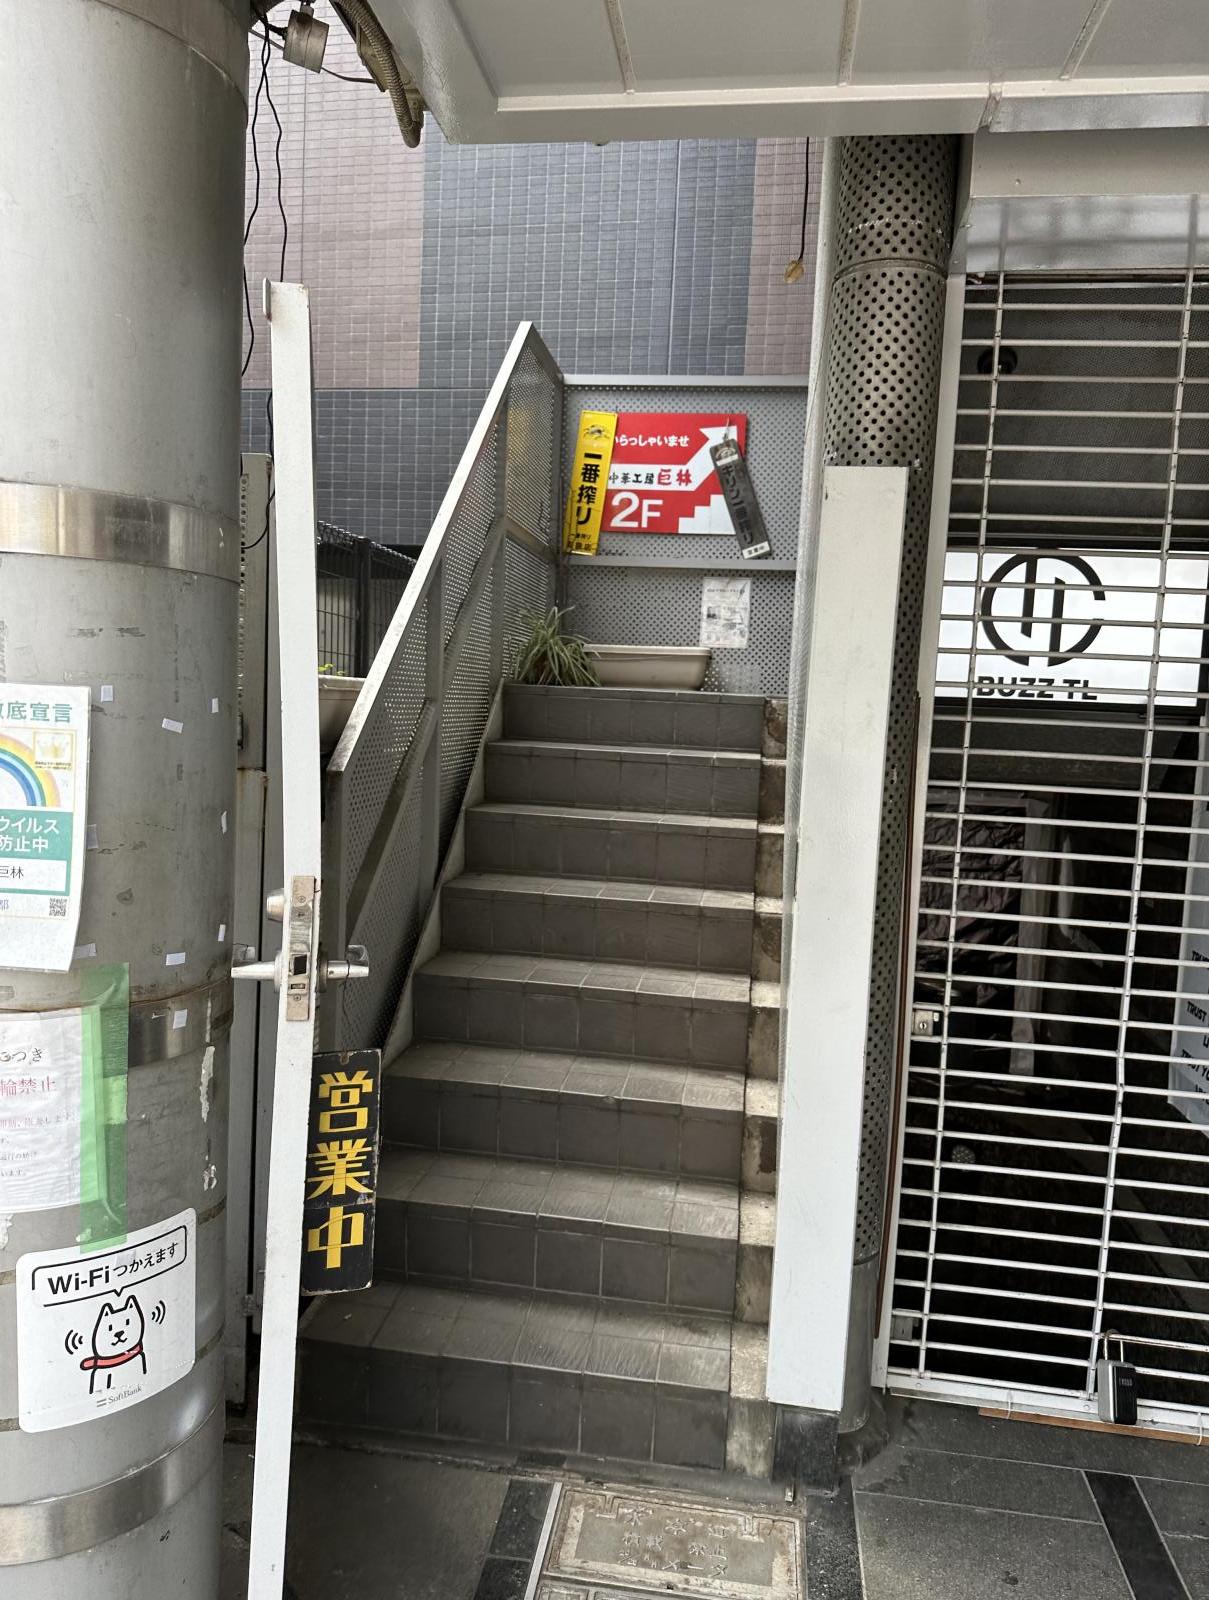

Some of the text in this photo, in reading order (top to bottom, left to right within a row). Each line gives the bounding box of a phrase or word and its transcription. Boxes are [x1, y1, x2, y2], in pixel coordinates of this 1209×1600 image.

[576, 452, 602, 525] 一番搾り
[610, 490, 663, 528] 2F
[976, 676, 1098, 700] BUZZ TL
[1187, 1001, 1207, 1022] TRUST
[307, 1070, 374, 1269] 営業中
[107, 1384, 142, 1405] SoftBank
